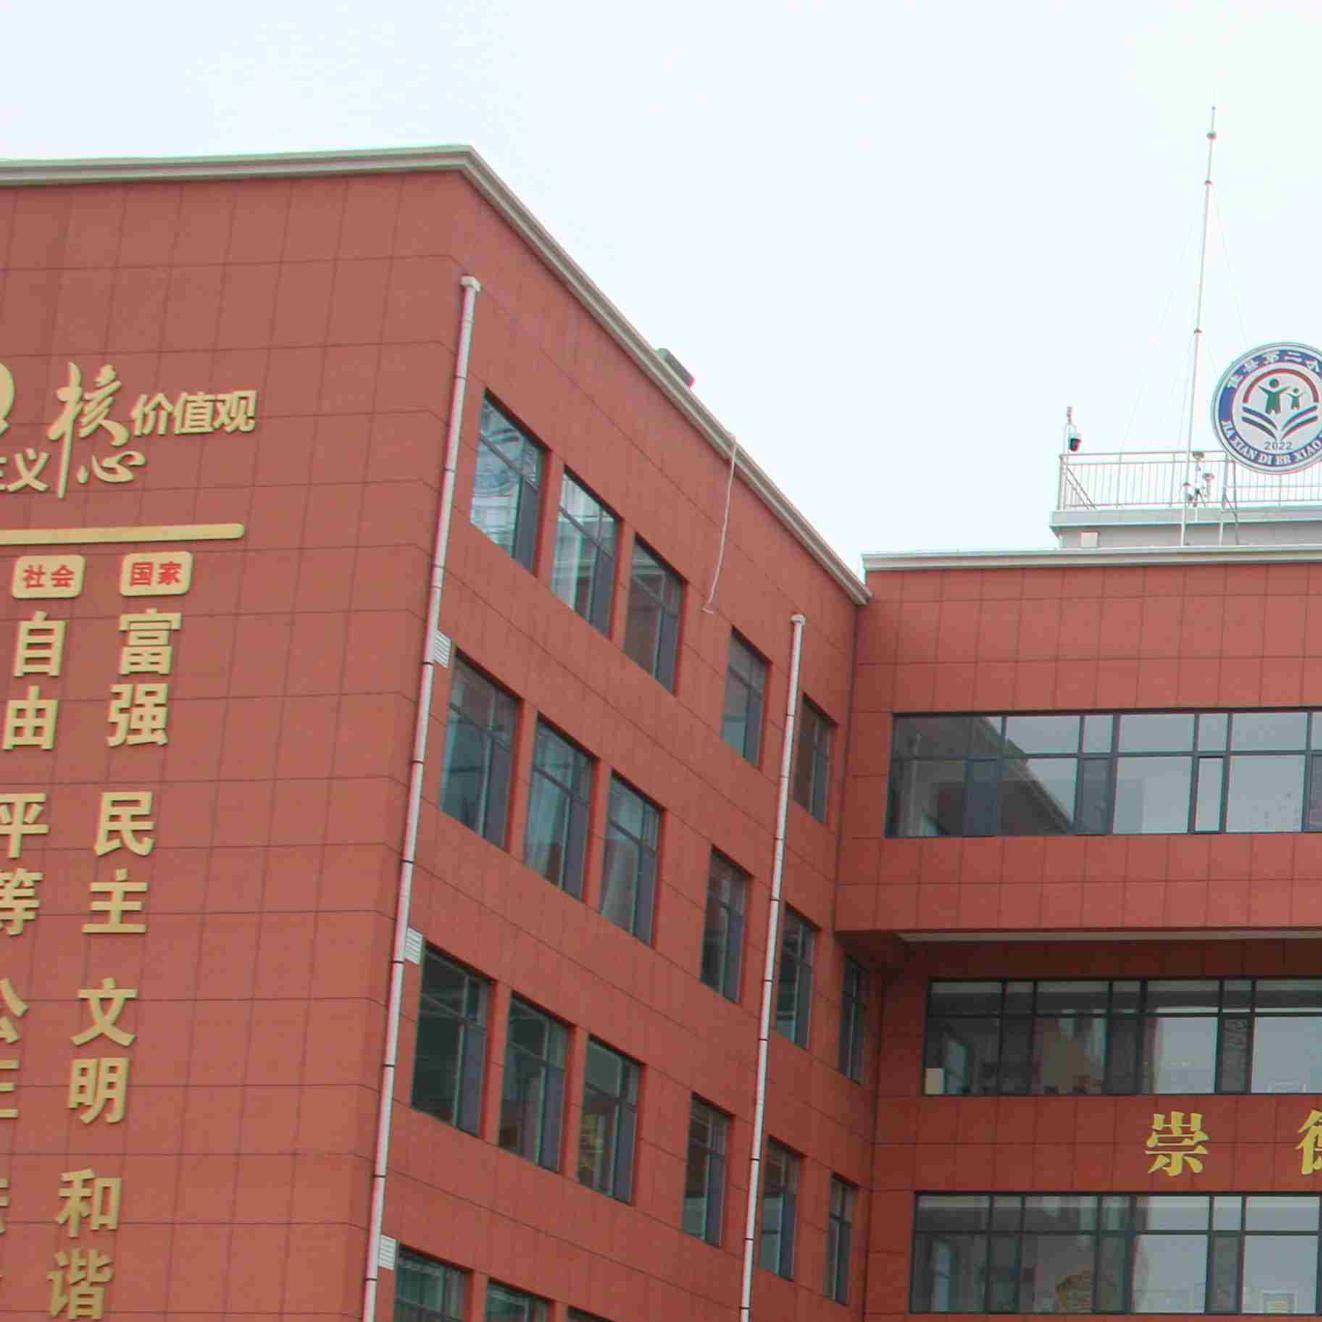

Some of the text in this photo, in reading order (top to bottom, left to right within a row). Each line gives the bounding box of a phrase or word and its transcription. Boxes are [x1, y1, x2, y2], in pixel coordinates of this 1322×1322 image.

[130, 389, 258, 436] 价值观
[1264, 441, 1292, 450] 2022
[23, 564, 75, 589] 社会
[130, 560, 183, 586] 国家
[1, 610, 67, 751] 自由
[106, 607, 182, 748] 富强
[81, 790, 155, 934] 民主
[69, 977, 138, 1125] 文明
[47, 1168, 123, 1321] 和谐
